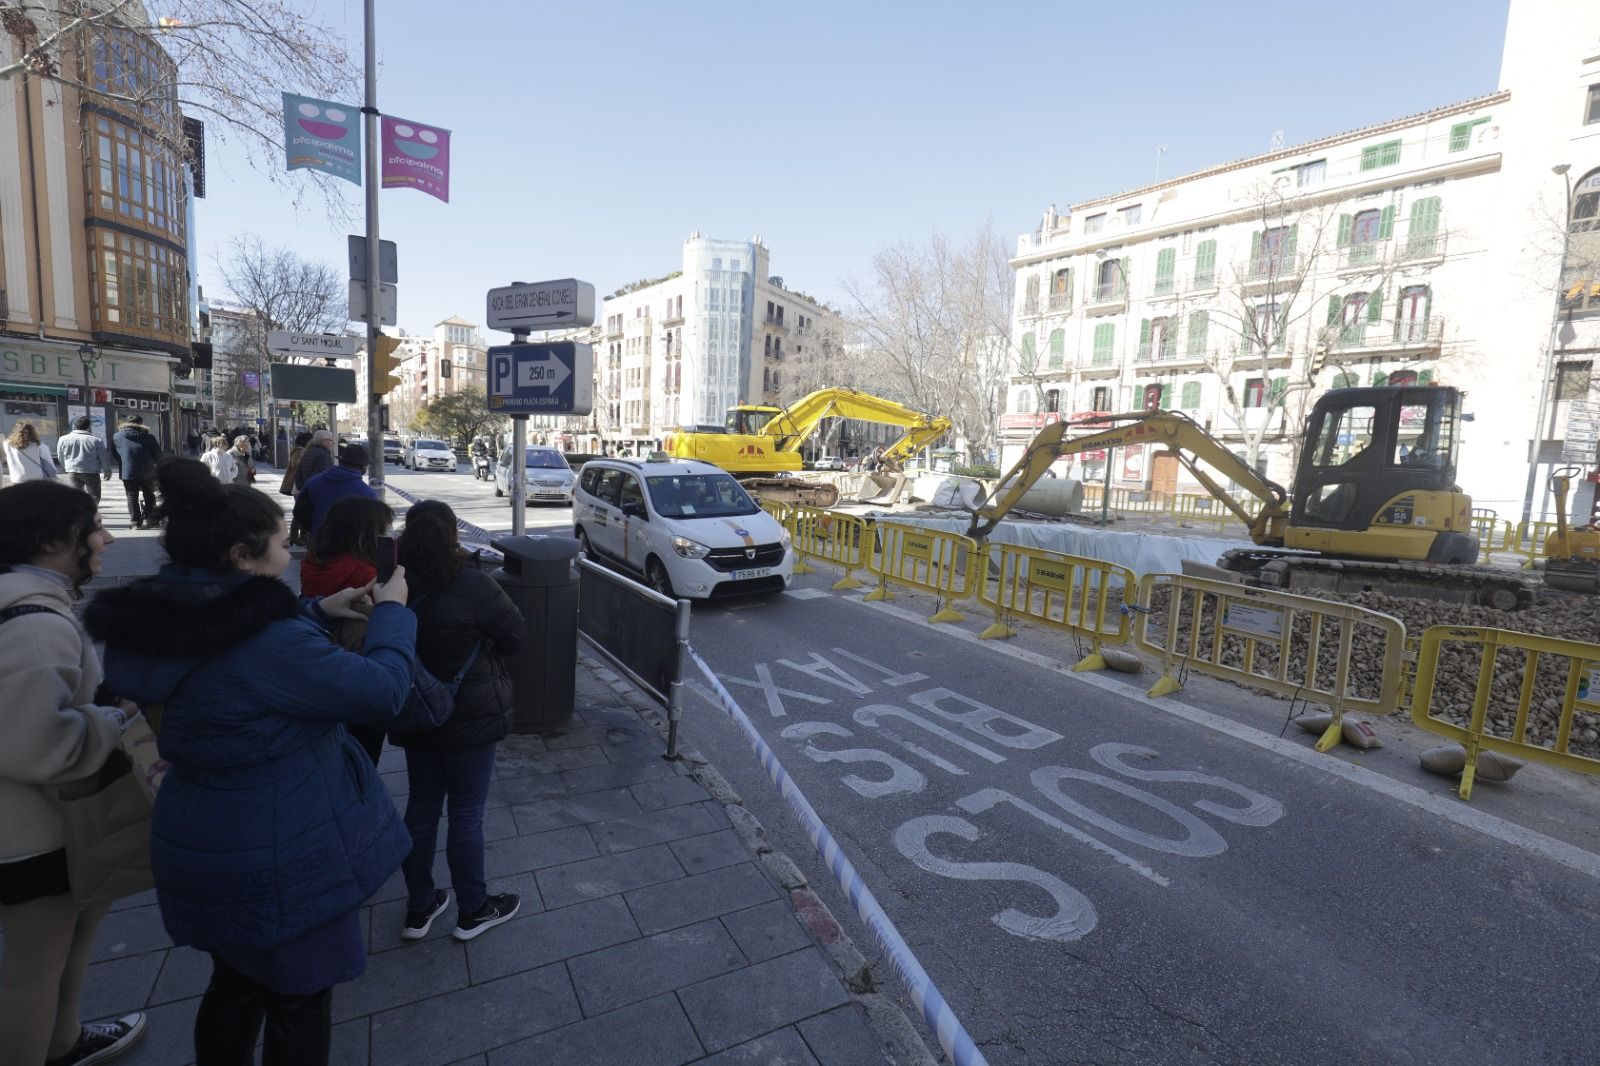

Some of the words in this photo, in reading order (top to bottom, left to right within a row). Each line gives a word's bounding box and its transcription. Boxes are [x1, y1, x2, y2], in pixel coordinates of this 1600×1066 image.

[301, 336, 319, 346] SANT
[320, 338, 343, 349] MIQUEL
[495, 357, 511, 393] P
[529, 366, 545, 380] 250
[546, 369, 555, 379] m
[127, 398, 170, 411] OPTICA
[1081, 437, 1123, 449] KOMATSU
[781, 687, 1064, 799] BUS
[894, 742, 1286, 942] SOLS
